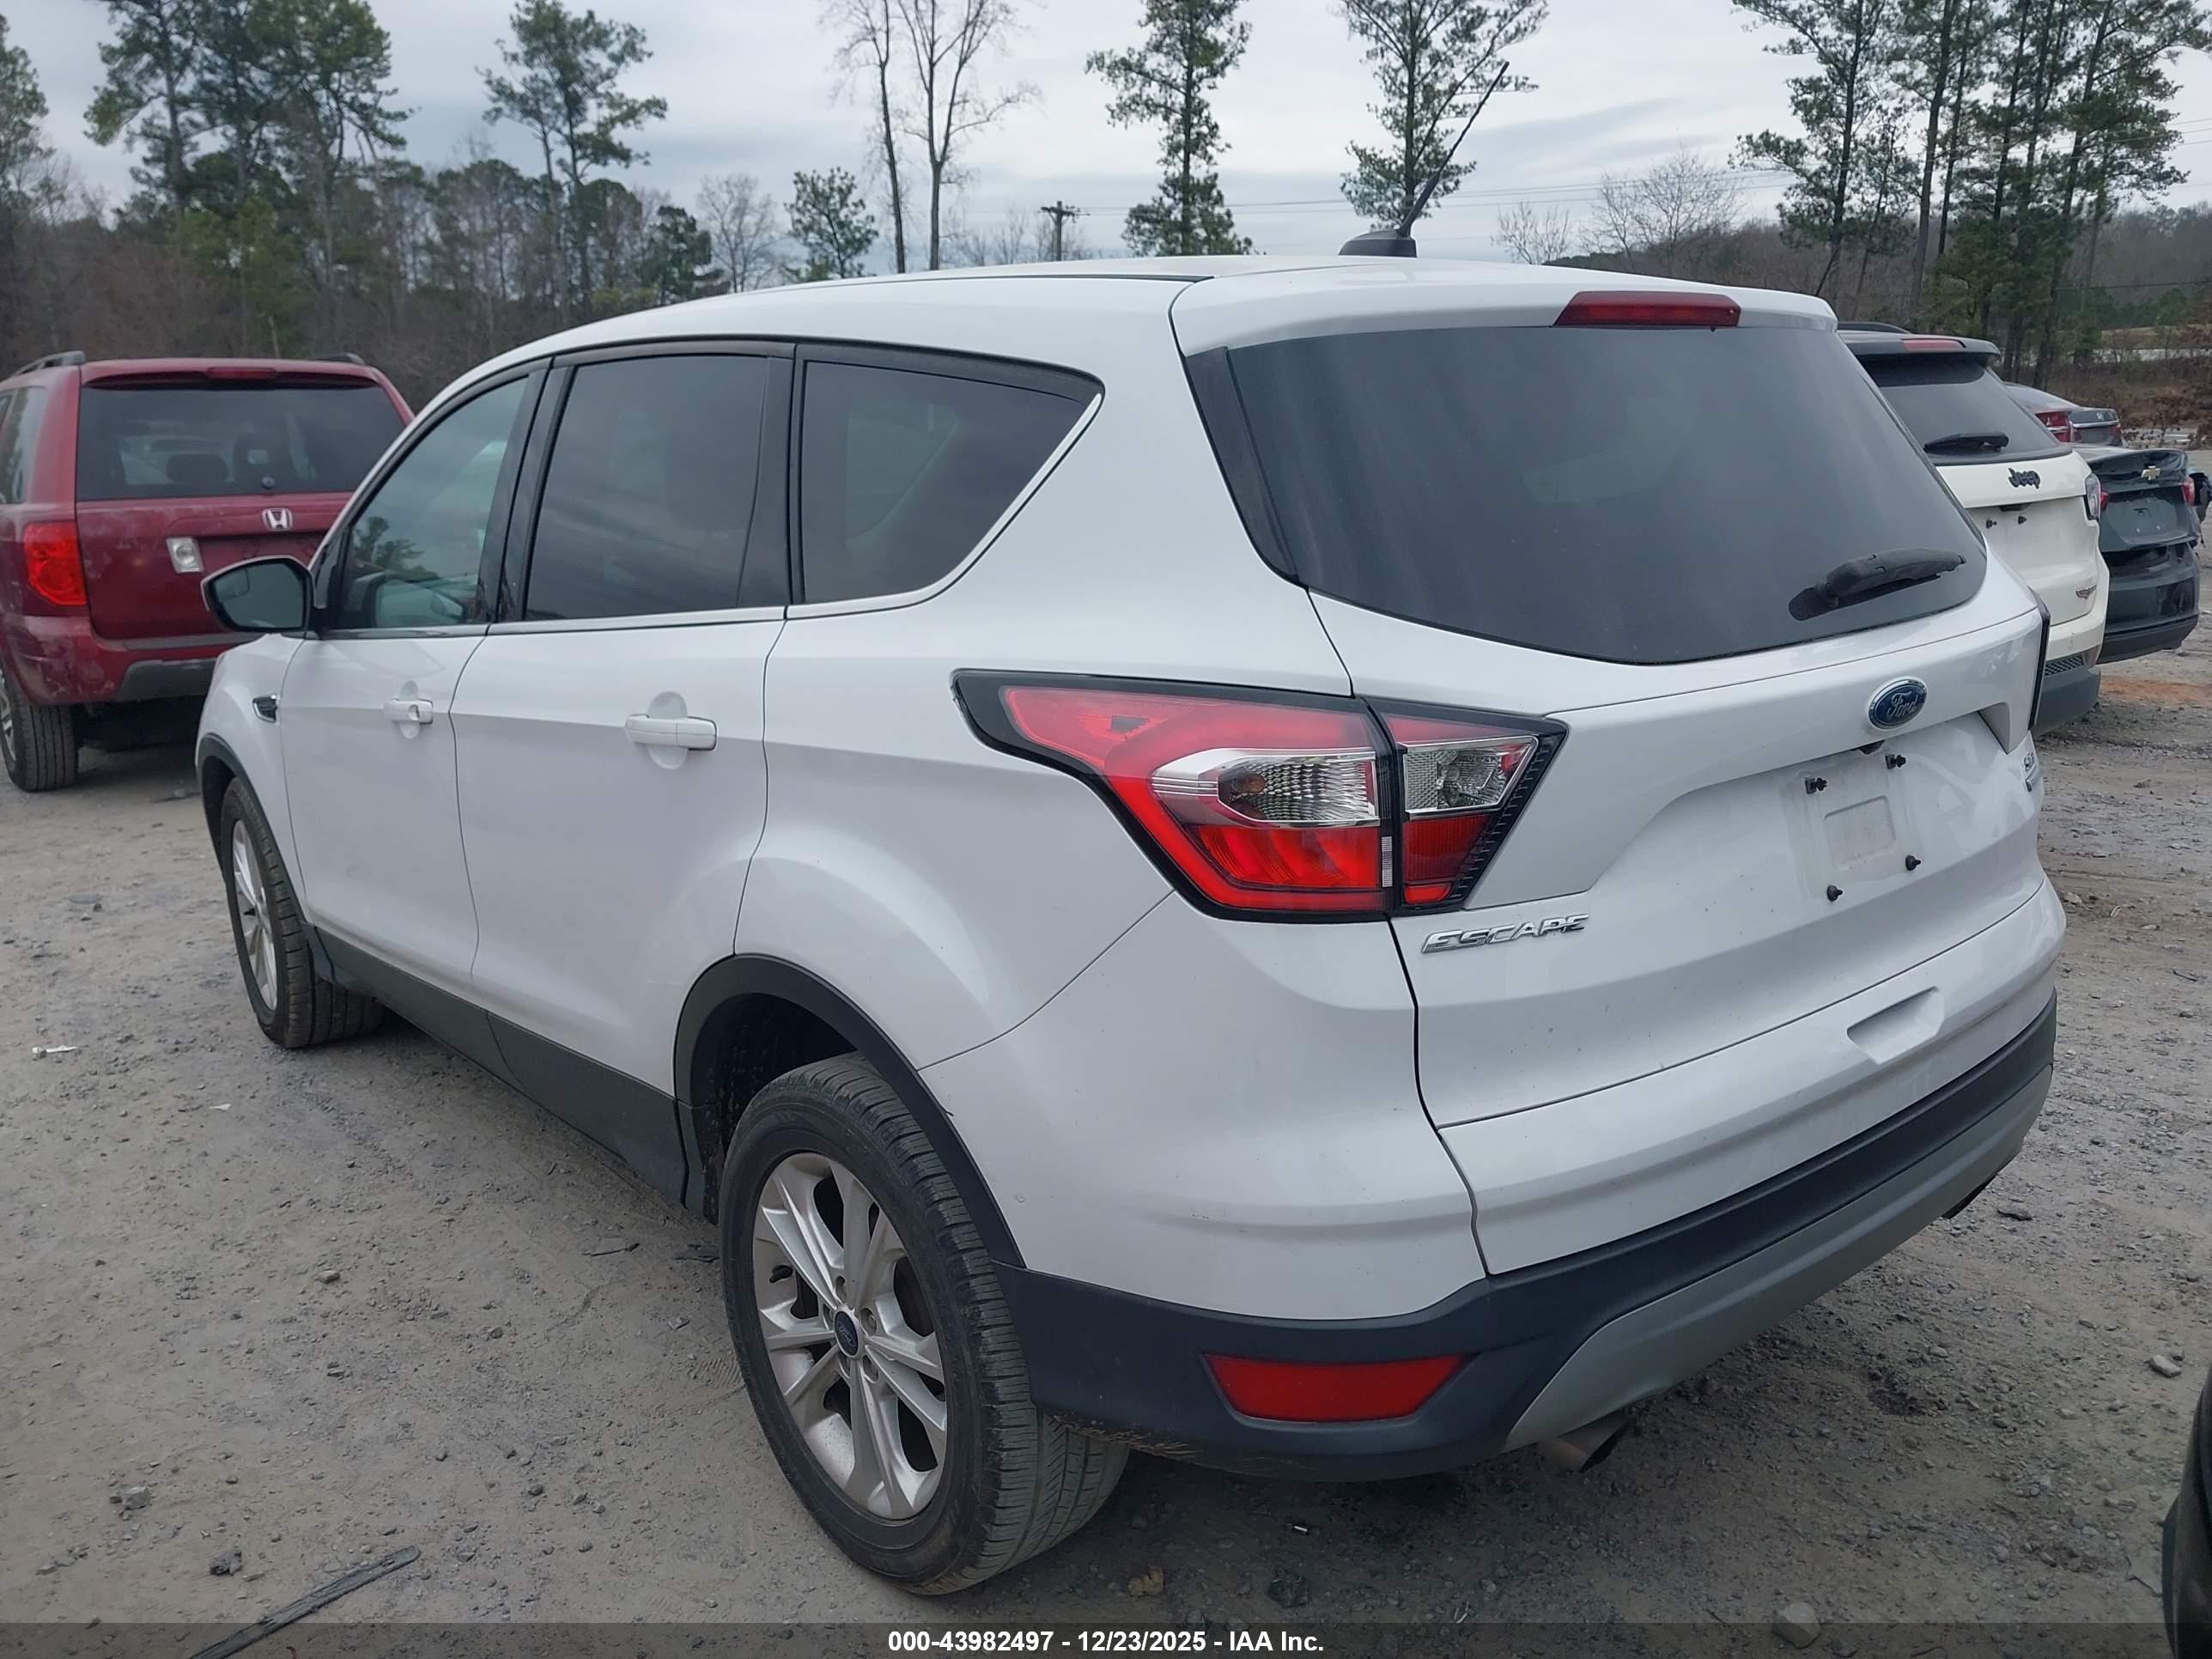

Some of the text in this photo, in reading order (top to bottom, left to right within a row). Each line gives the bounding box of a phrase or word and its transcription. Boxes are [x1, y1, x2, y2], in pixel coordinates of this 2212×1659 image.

[2008, 467, 2041, 489] Jeep
[1887, 690, 1919, 718] Ford
[1421, 914, 1589, 953] ESCAPE
